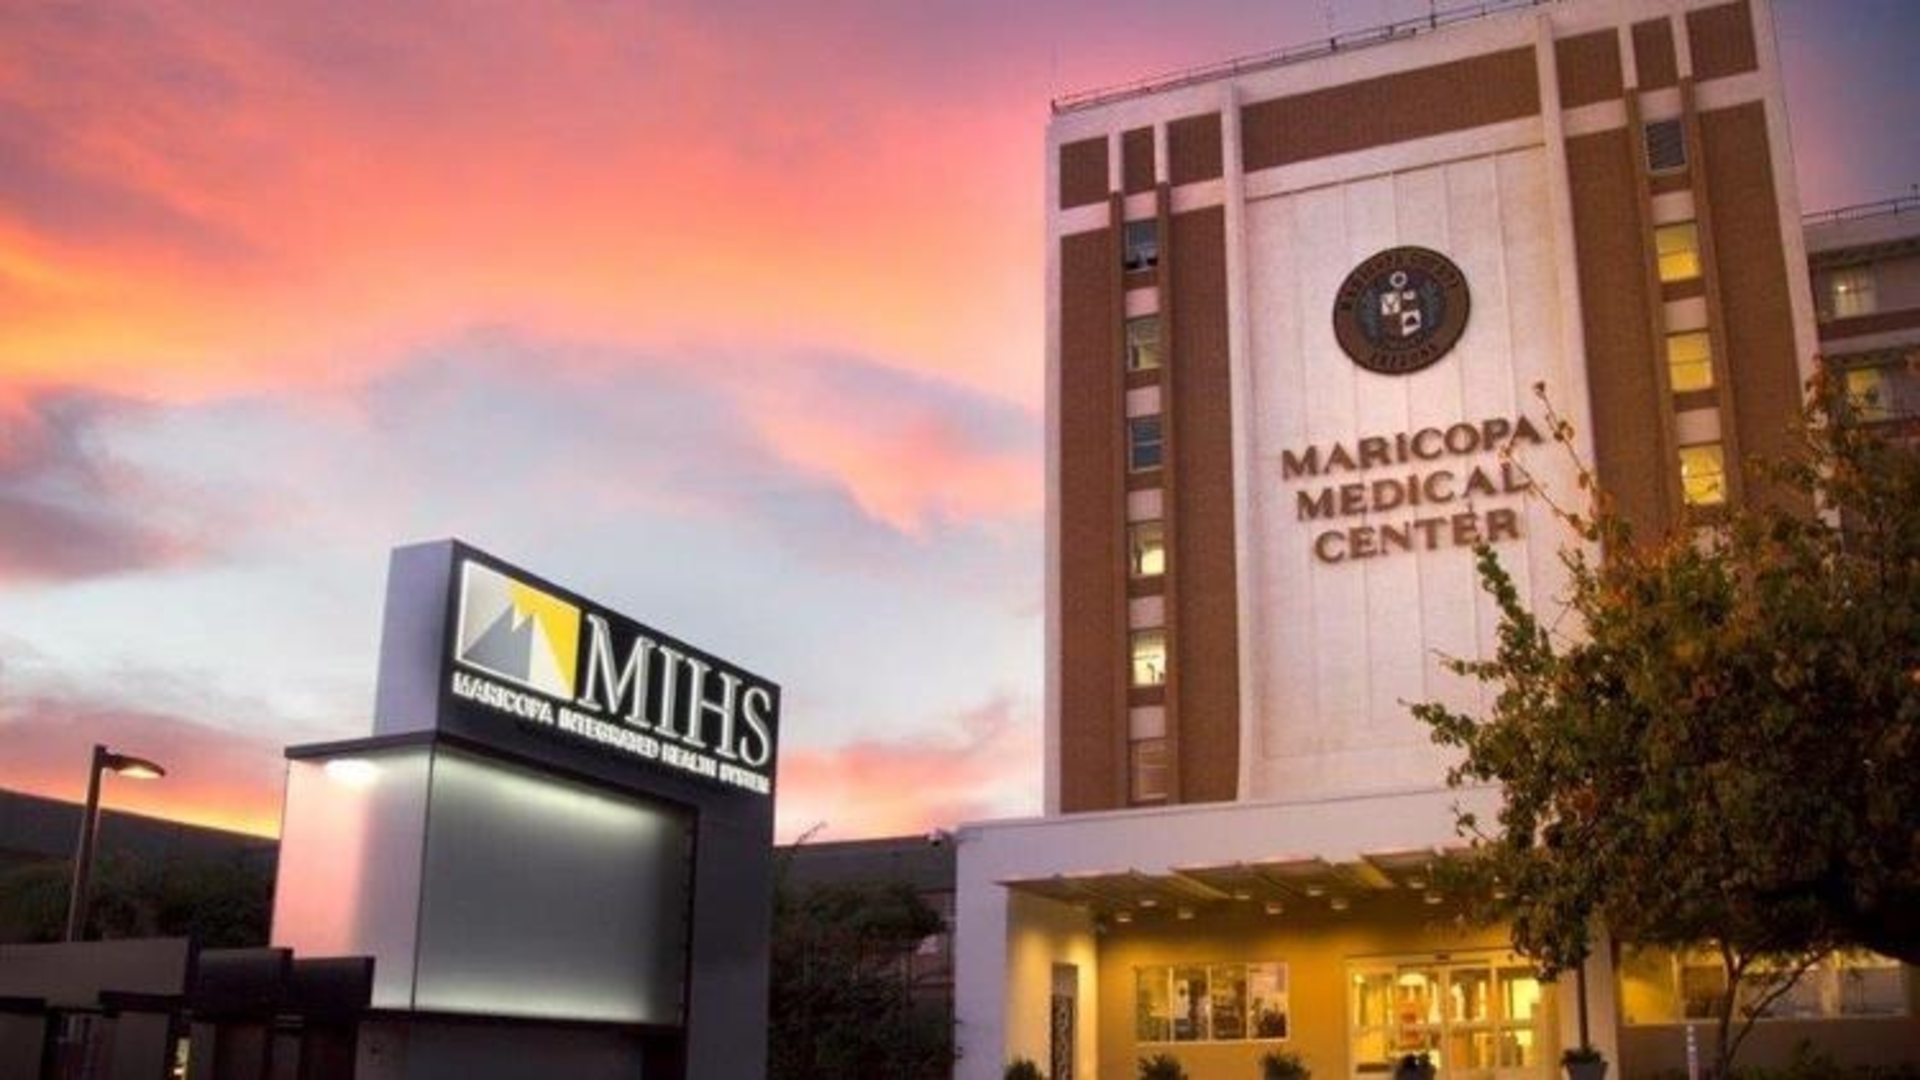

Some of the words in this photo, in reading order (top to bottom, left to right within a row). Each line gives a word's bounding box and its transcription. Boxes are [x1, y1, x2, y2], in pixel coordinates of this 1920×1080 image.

[1282, 415, 1543, 480] MARICOPA
[1297, 462, 1531, 522] MEDICAL
[1314, 508, 1519, 564] CENTER
[578, 613, 771, 767] MIHS
[452, 671, 554, 725] MARICOPA
[558, 707, 660, 758] INTEGRATED
[662, 743, 717, 778] HEALTH
